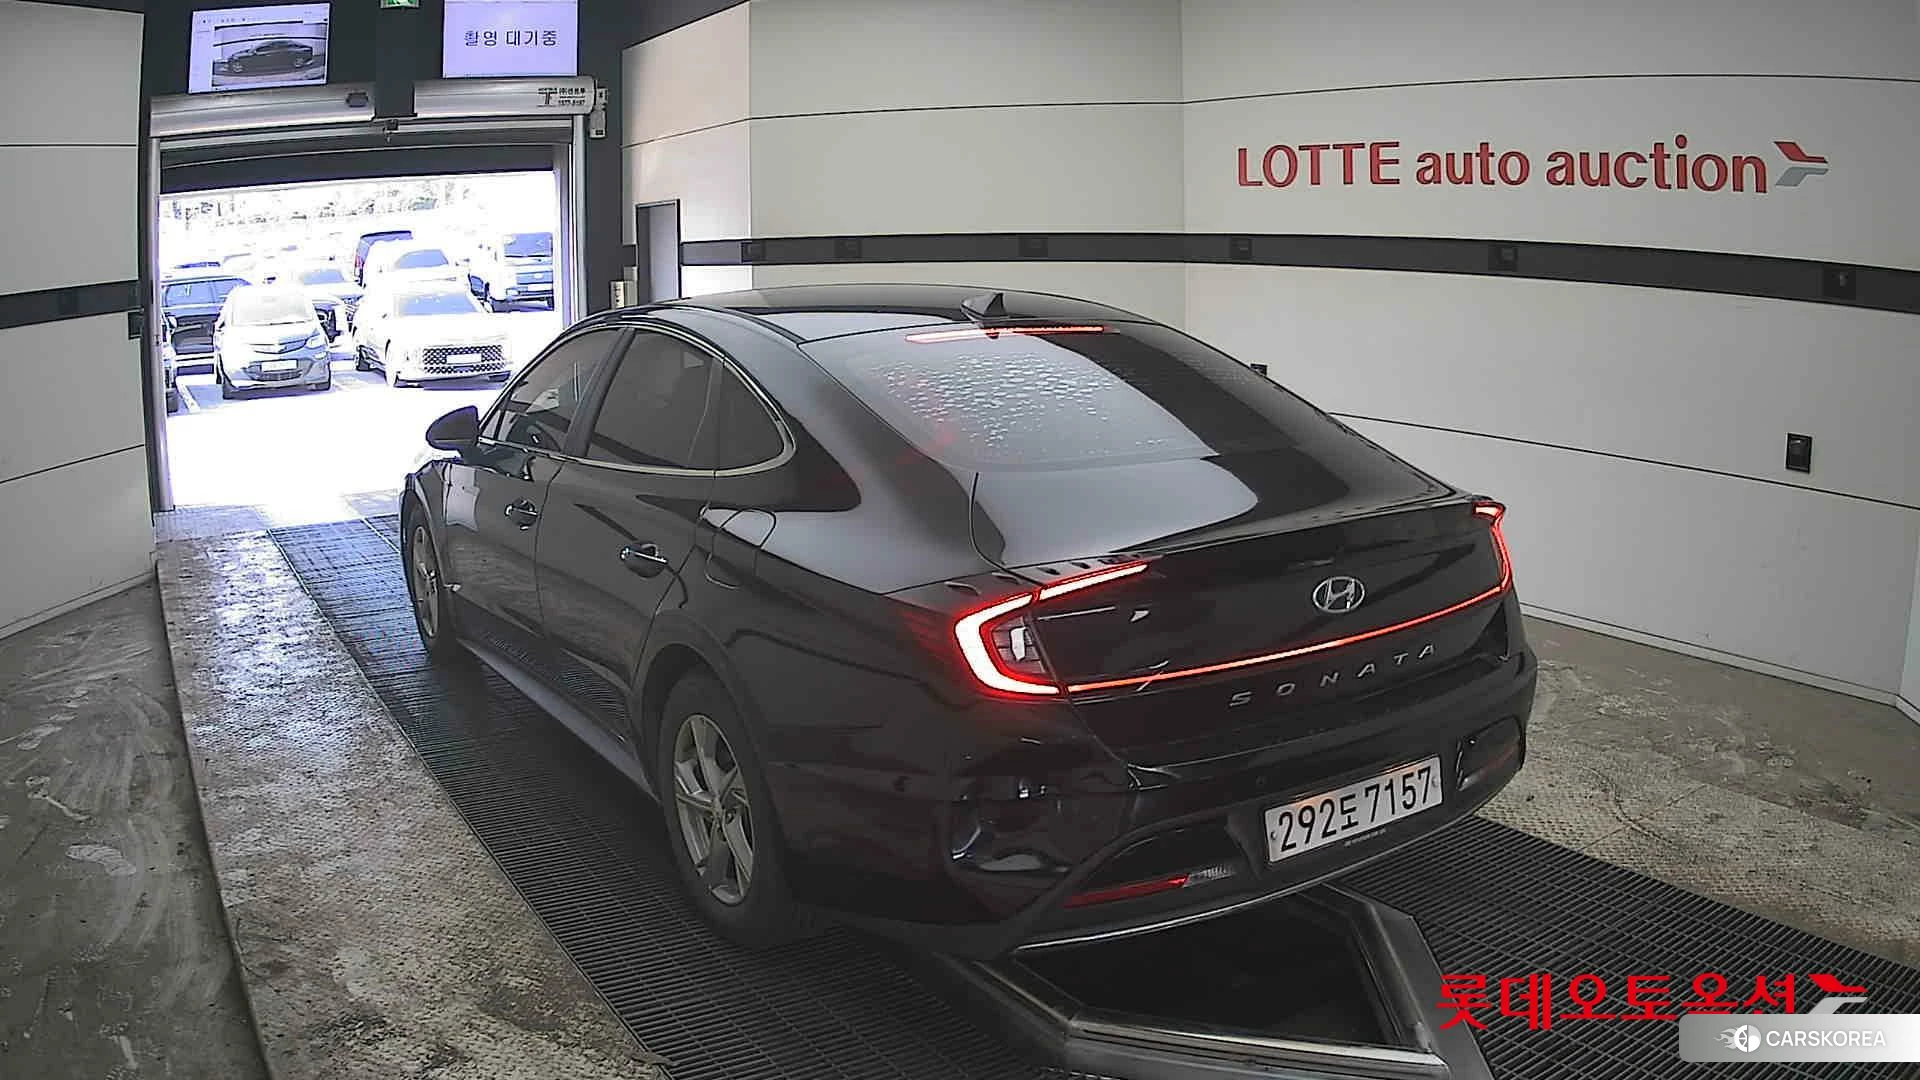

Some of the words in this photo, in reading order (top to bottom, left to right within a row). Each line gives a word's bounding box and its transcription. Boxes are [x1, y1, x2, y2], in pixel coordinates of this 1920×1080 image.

[464, 30, 498, 47] 촬영
[506, 30, 558, 47] 대기중
[1237, 141, 1400, 187] LOTTE
[1415, 142, 1530, 186] auto
[1547, 135, 1768, 193] auction
[1229, 643, 1437, 707] SONATA
